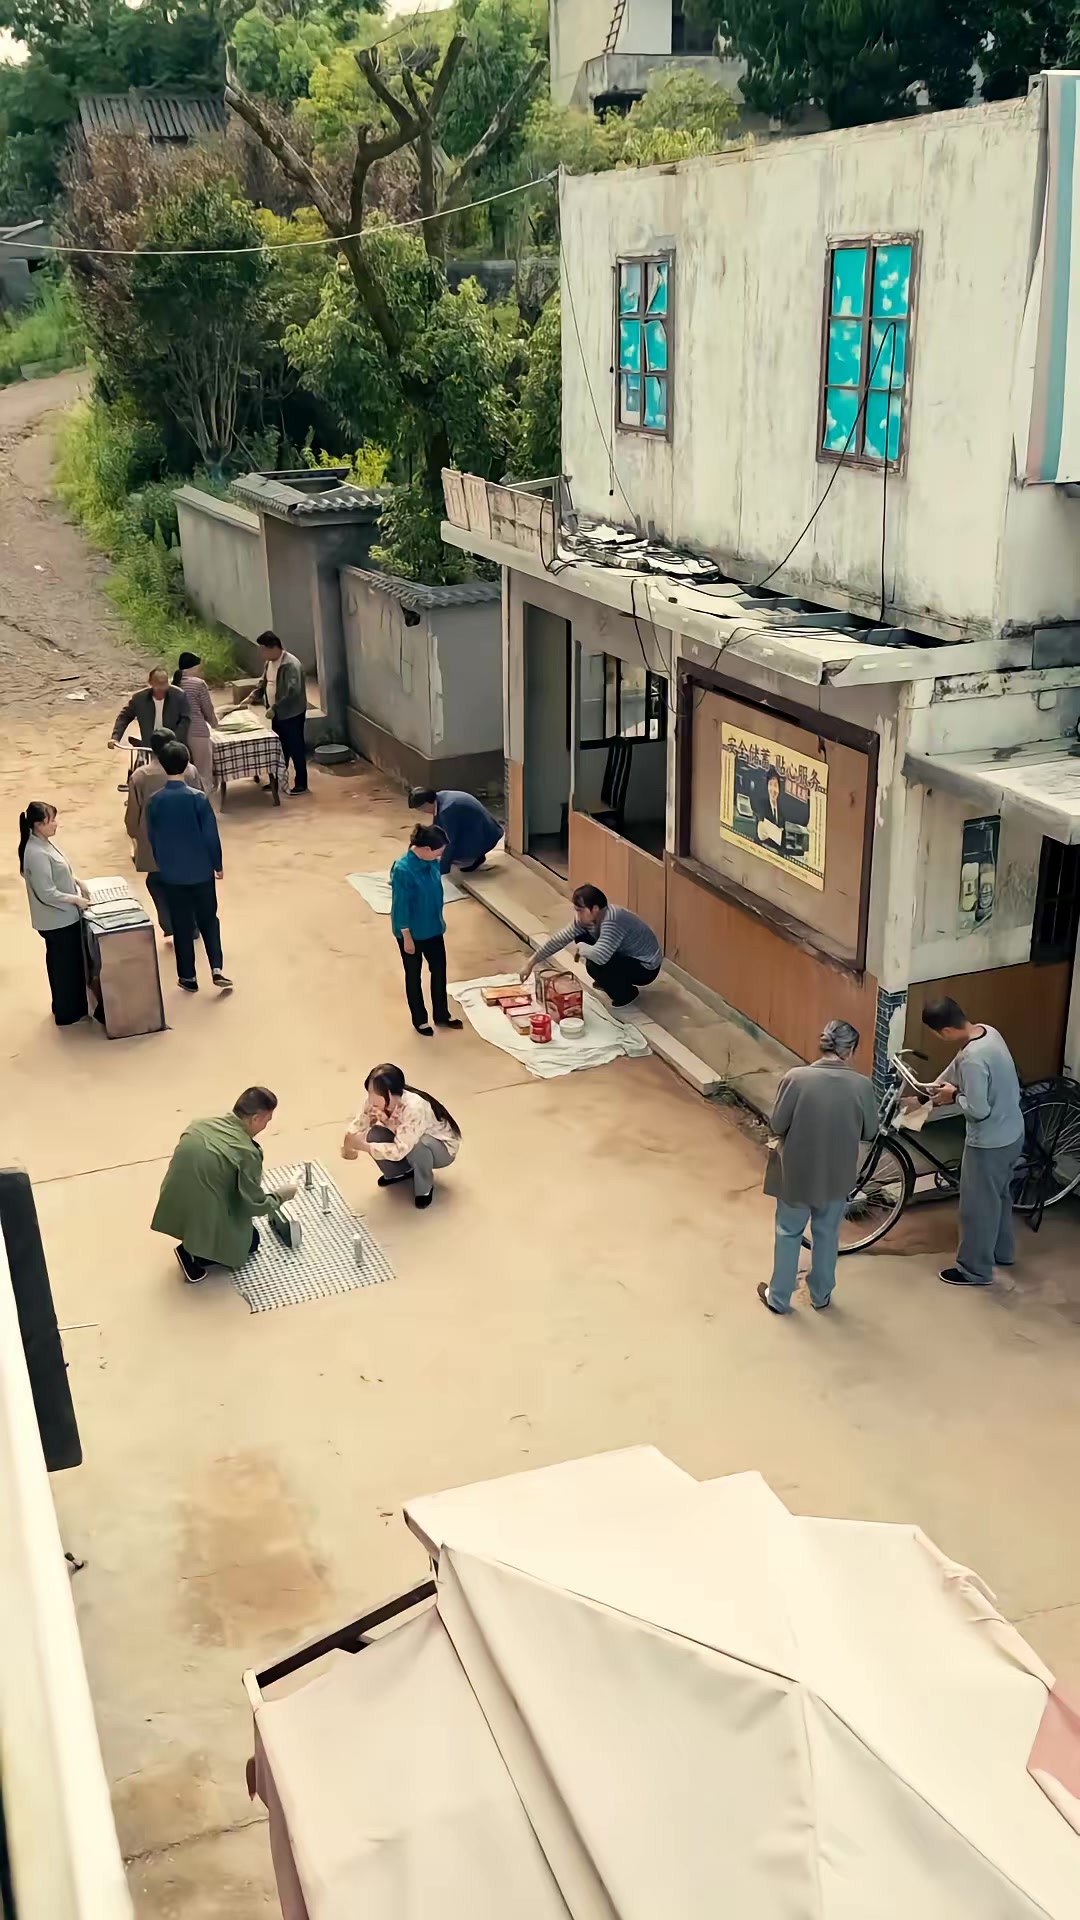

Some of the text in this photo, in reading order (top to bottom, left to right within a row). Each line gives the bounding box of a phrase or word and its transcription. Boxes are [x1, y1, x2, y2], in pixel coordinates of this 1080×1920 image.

[727, 736, 821, 791] 安全储蓄 贴心服务
